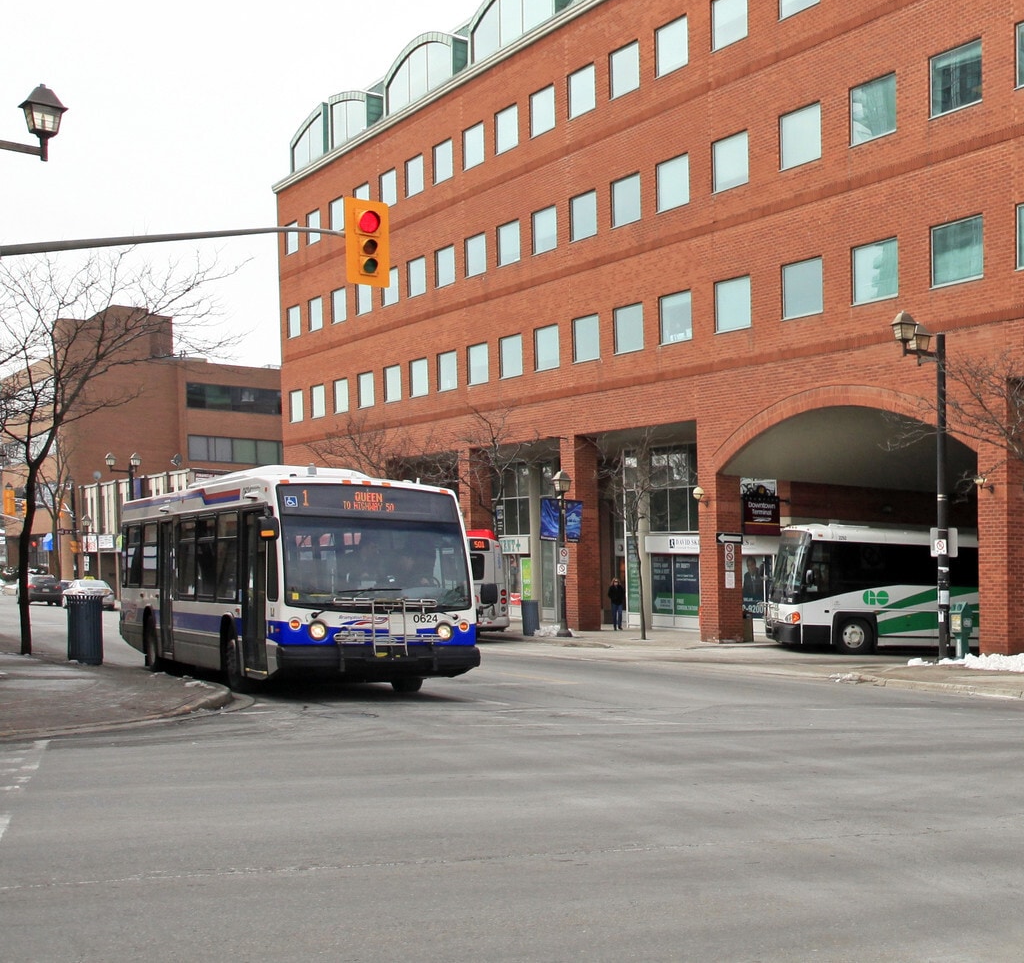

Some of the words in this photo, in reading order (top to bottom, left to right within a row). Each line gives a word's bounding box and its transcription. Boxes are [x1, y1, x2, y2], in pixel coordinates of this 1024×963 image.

[302, 489, 309, 507] 1
[354, 491, 383, 503] QUEEN
[343, 500, 351, 510] TO
[353, 501, 383, 512] HIGHWAY
[385, 503, 395, 512] 50
[748, 501, 776, 509] Downtown
[473, 540, 485, 549] 501
[413, 614, 439, 624] 0624
